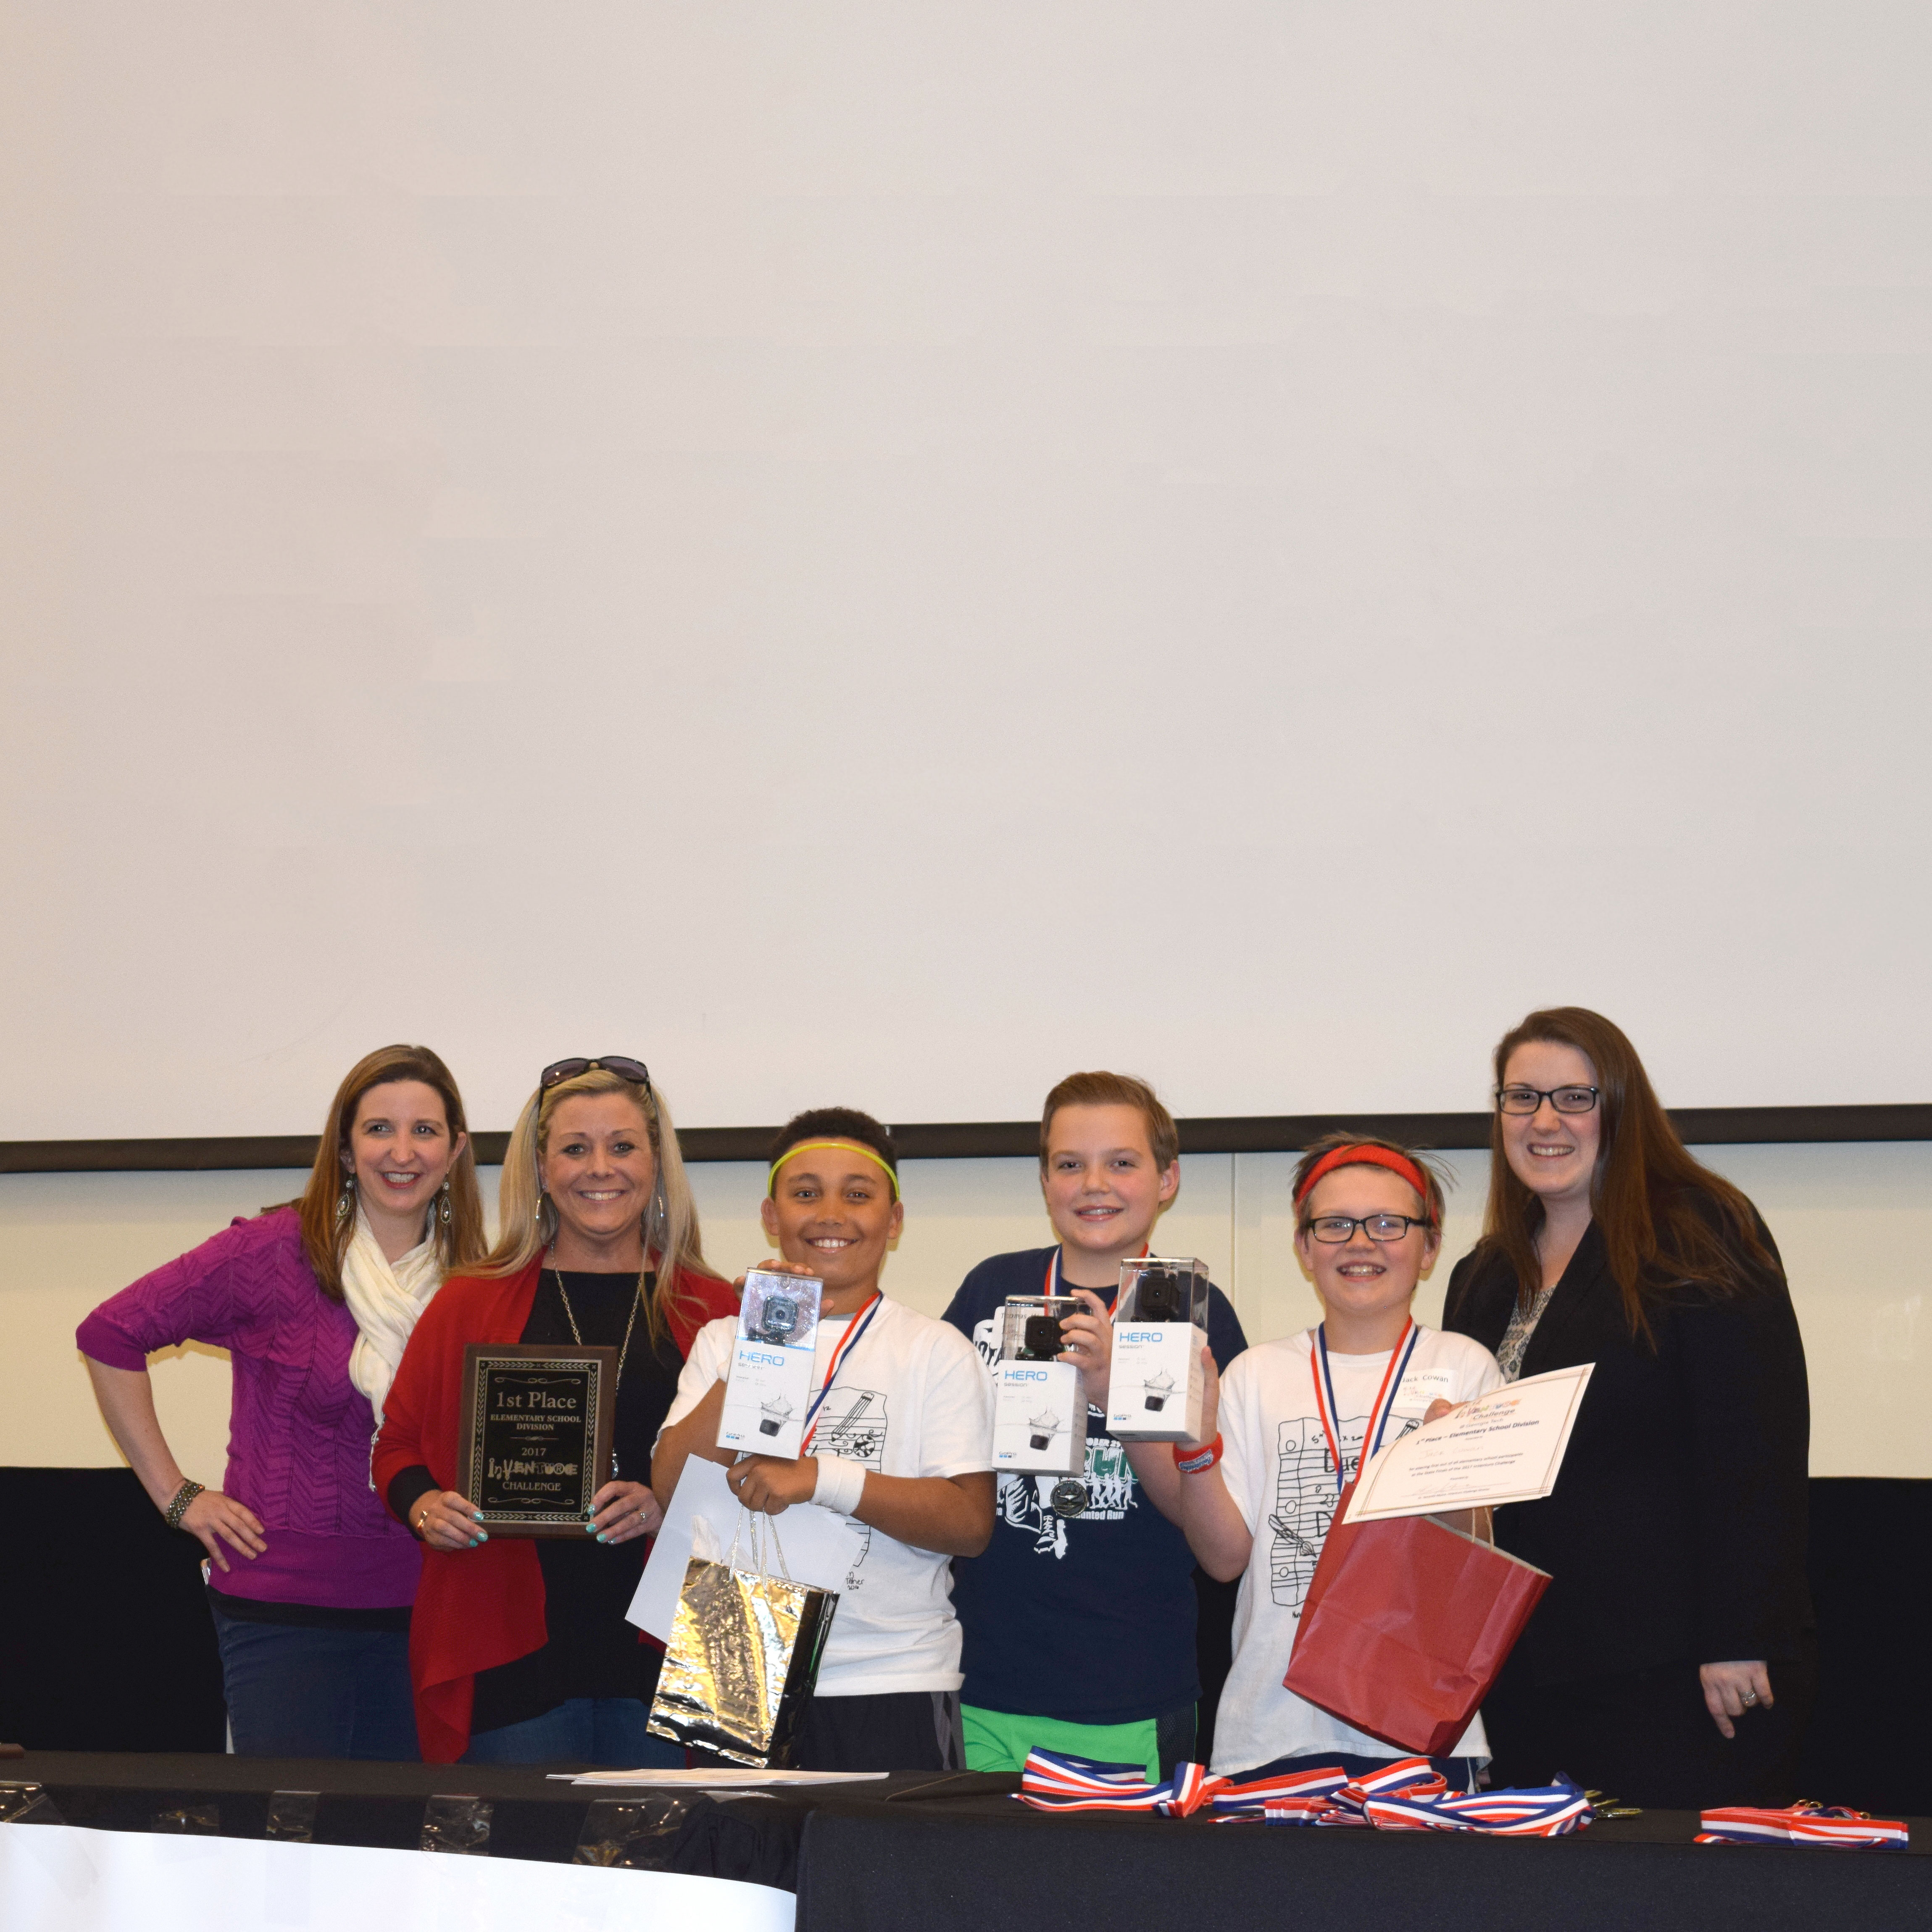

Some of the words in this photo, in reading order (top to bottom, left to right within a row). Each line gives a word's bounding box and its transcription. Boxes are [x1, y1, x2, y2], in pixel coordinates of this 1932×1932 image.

[1119, 1332, 1163, 1342] HERO
[739, 1349, 784, 1366] HERO
[1005, 1370, 1048, 1381] HERO
[1422, 1374, 1448, 1383] Cowan
[497, 1391, 522, 1407] 1st
[527, 1391, 576, 1408] Place
[1473, 1408, 1515, 1420] Challenge
[1449, 1428, 1487, 1438] Elementary
[1488, 1423, 1511, 1432] School
[1512, 1419, 1540, 1428] Division
[521, 1448, 546, 1456] 2017
[503, 1482, 561, 1491] CHALLENGE
[1107, 1510, 1124, 1520] Run
